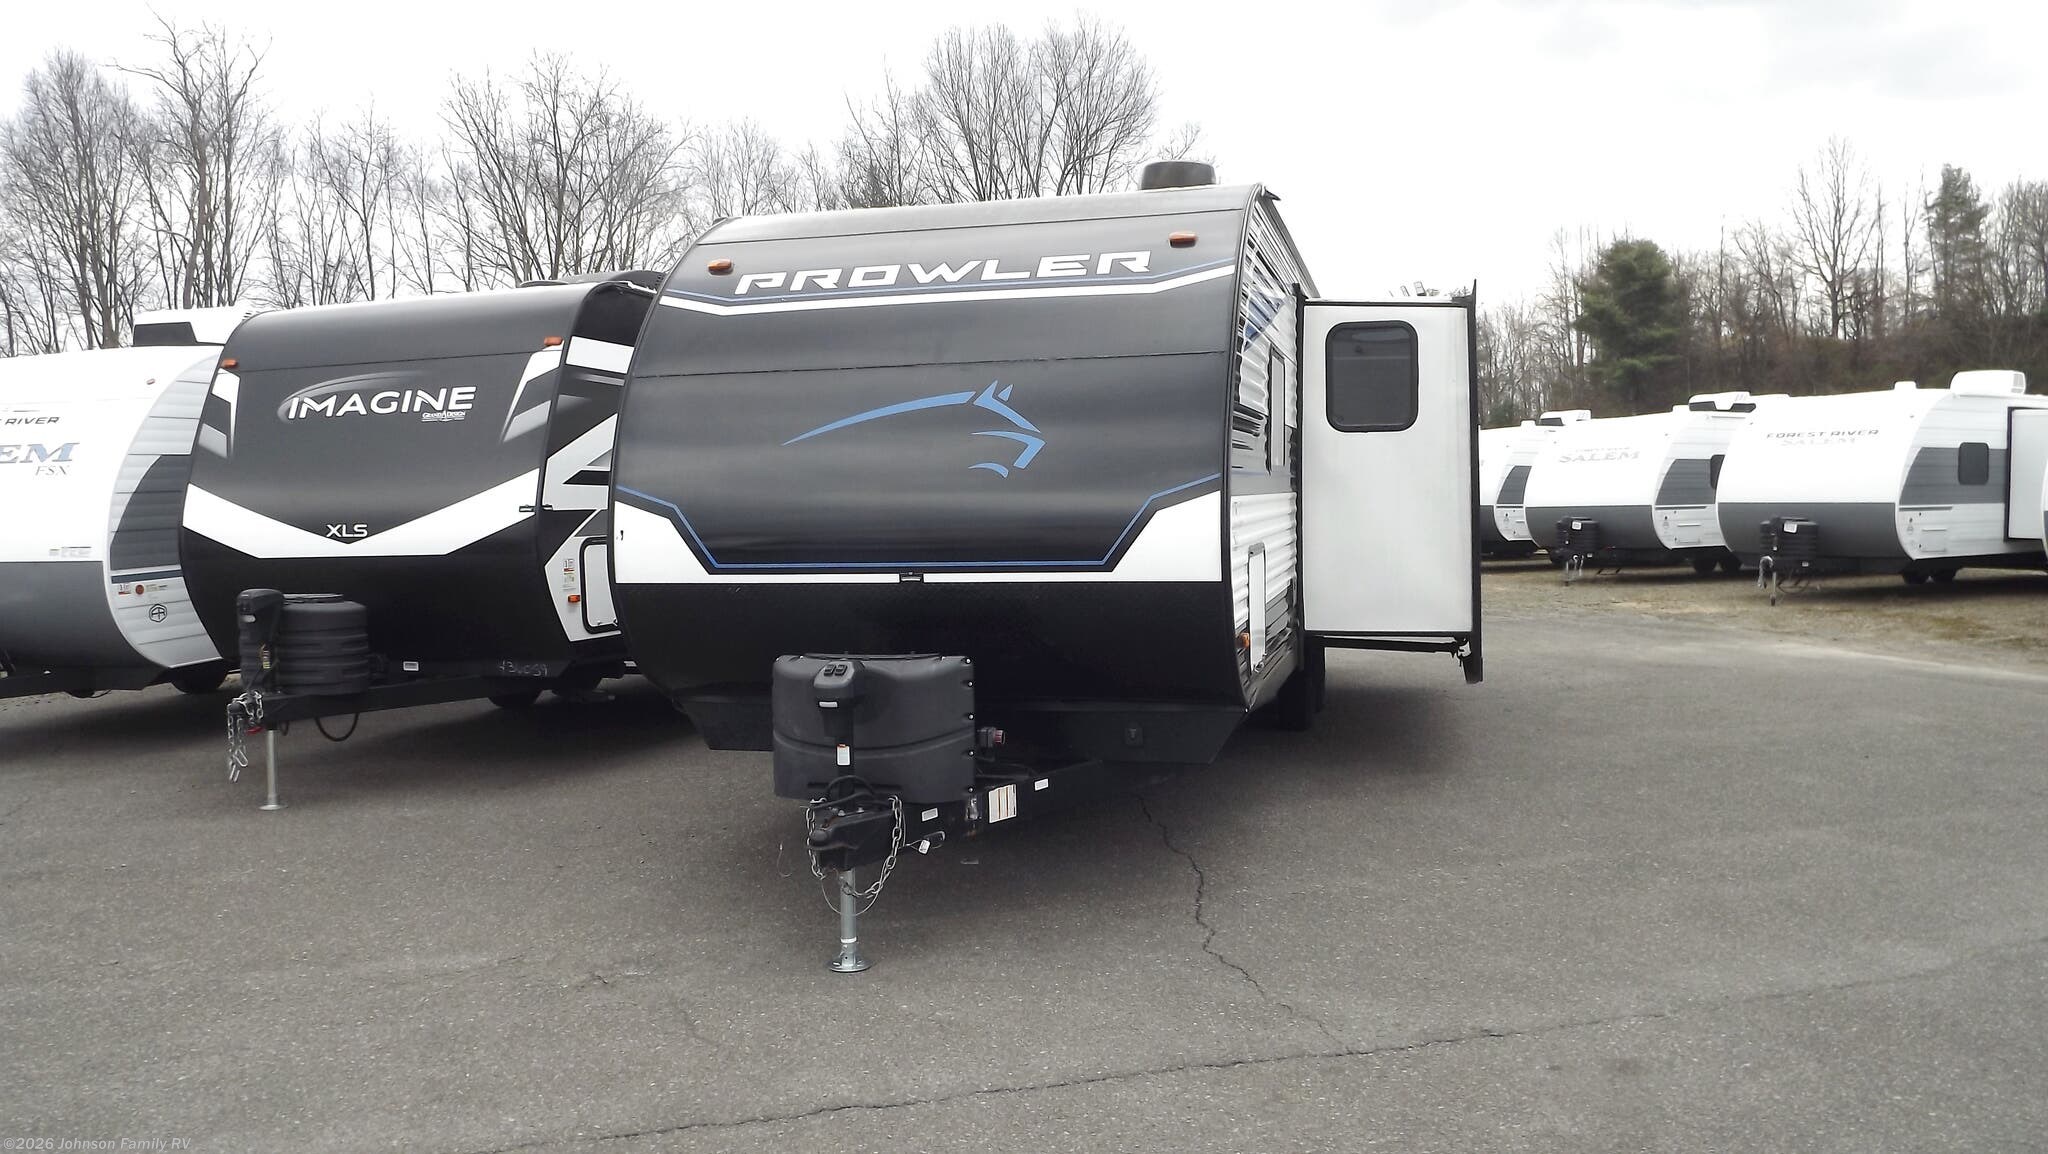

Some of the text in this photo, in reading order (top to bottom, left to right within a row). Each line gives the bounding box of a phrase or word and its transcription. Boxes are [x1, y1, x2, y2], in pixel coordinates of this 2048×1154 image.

[734, 250, 1152, 295] PROWLER
[288, 386, 477, 419] IMAGINE
[4, 416, 61, 425] RIVER
[1766, 429, 1880, 439] FOREST RIVER
[326, 524, 368, 538] XLS
